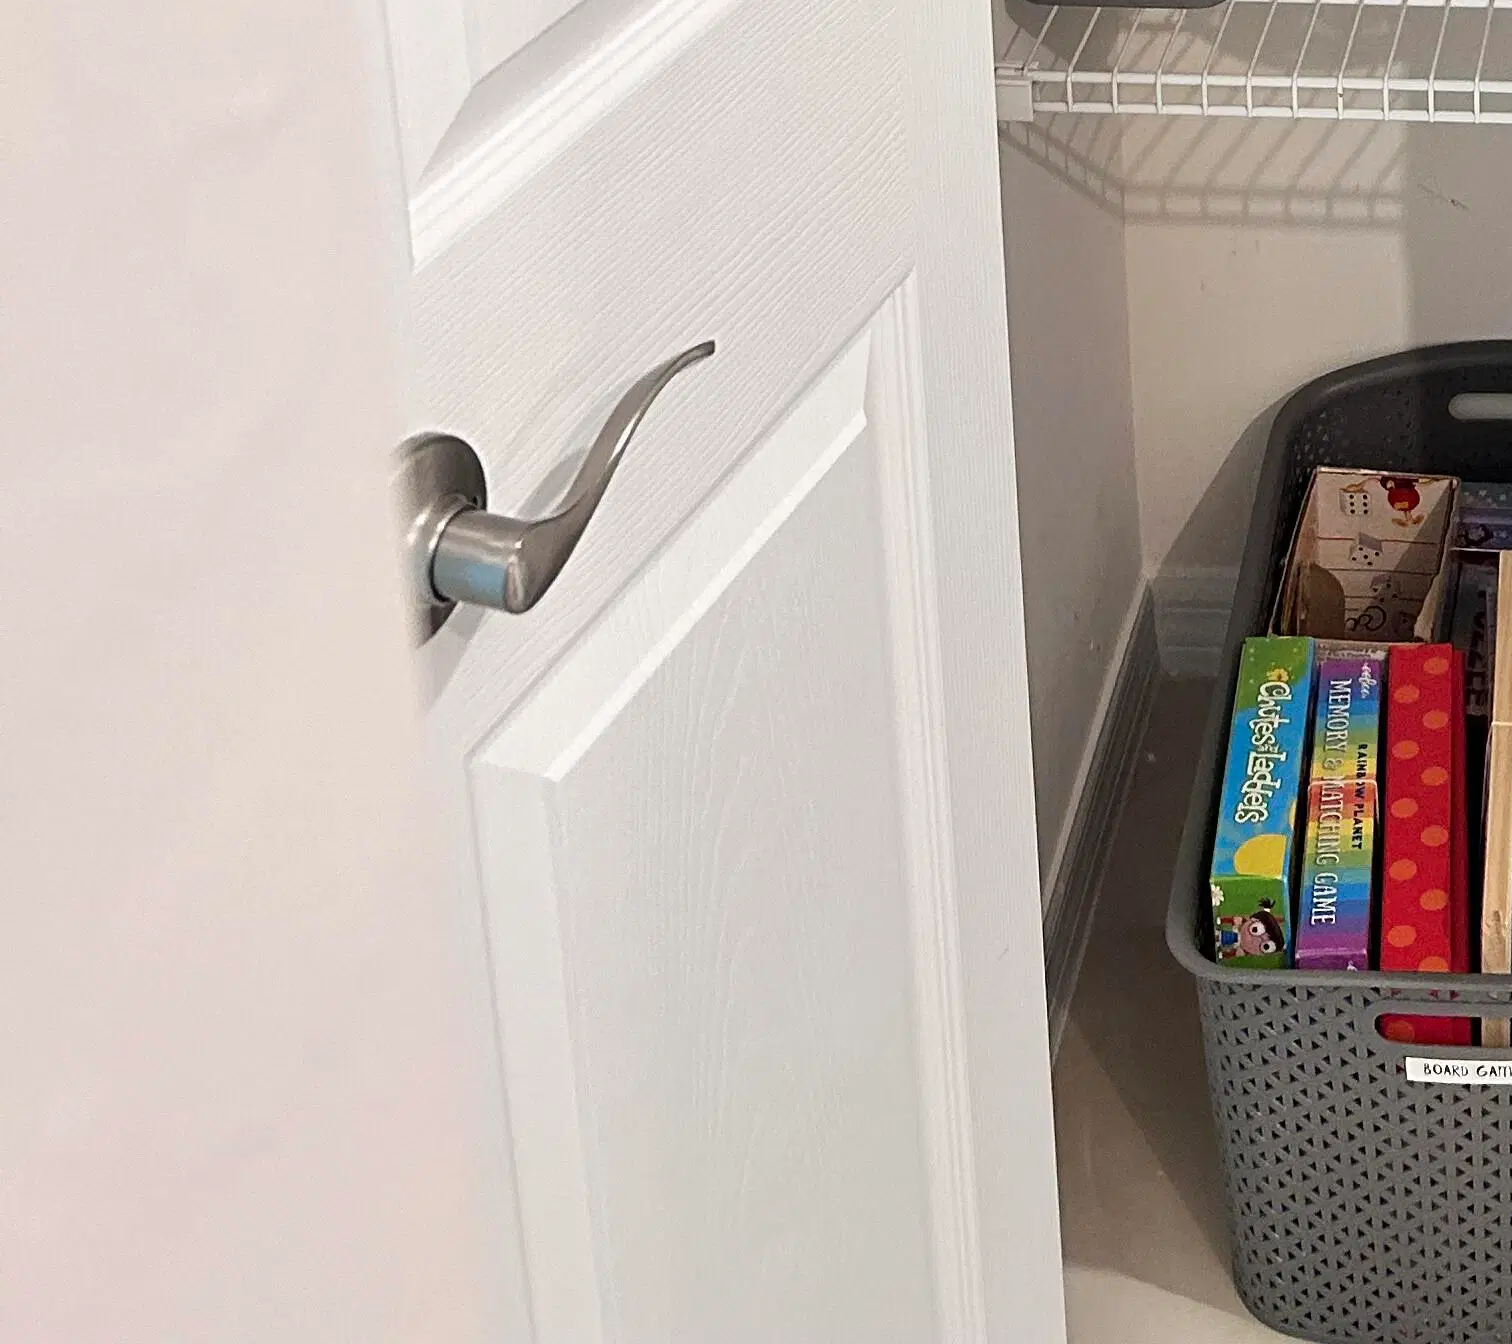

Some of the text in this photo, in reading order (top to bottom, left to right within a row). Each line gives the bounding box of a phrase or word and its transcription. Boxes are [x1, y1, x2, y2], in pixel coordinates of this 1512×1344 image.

[1234, 681, 1292, 824] Chutes Ladders
[1311, 678, 1352, 925] MEMORY & MATCHING GAME
[1352, 743, 1368, 850] RAINBOW PLANET
[1423, 1063, 1469, 1077] BOARD
